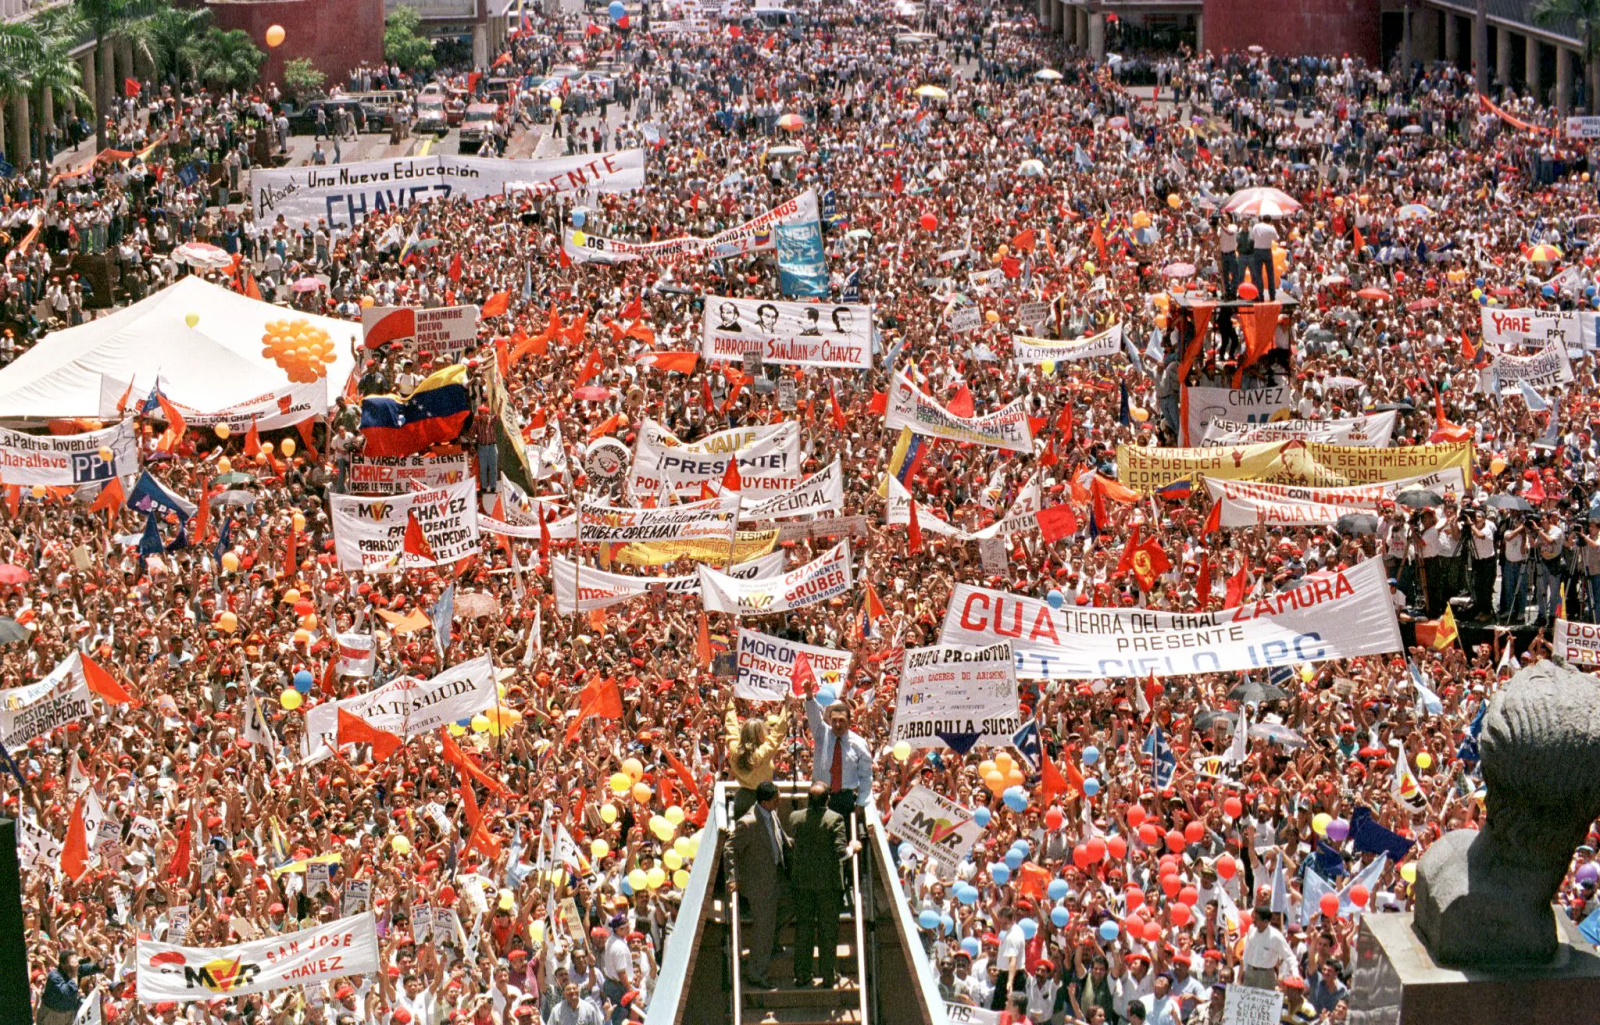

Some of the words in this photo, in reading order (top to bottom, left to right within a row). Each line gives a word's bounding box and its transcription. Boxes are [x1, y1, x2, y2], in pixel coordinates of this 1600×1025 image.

[308, 171, 335, 188] Una
[339, 168, 390, 185] Nueva
[429, 309, 463, 321] HOMBRE
[1491, 312, 1531, 335] YARE
[417, 322, 443, 331] NUEVO
[821, 339, 862, 363] CHAVEZ
[1228, 388, 1284, 406] CHAVEZ
[290, 403, 312, 413] MAS
[13, 433, 49, 451] Patria
[370, 456, 407, 467] VARGAS
[429, 453, 465, 464] SIENTE
[1313, 455, 1332, 465] UN
[351, 466, 394, 482] CHAVEZ
[1287, 488, 1311, 500] CON
[1313, 486, 1384, 504] CHAVEZ
[358, 500, 394, 521] MVR
[412, 490, 448, 504] AHORA
[1310, 505, 1332, 521] LA
[580, 511, 637, 528] CHAVEZ
[784, 570, 846, 601] GRUBER
[788, 584, 846, 608] GOBERNADOR
[960, 592, 1061, 646] CUA
[1060, 609, 1125, 635] TIERRA
[1131, 613, 1165, 634] DEL
[1117, 625, 1244, 653] PRESENTE
[1567, 637, 1600, 649] PARR
[908, 649, 940, 669] GRUPO
[943, 643, 1011, 663] PROMOTOR
[388, 702, 410, 717] TE
[412, 678, 477, 712] SALUDA
[896, 720, 975, 740] PARROQUIA
[911, 811, 965, 849] MVR
[266, 940, 299, 963] SAN
[309, 933, 354, 951] JOSE
[185, 954, 261, 993] MVR
[282, 956, 345, 980] CHAVEZ
